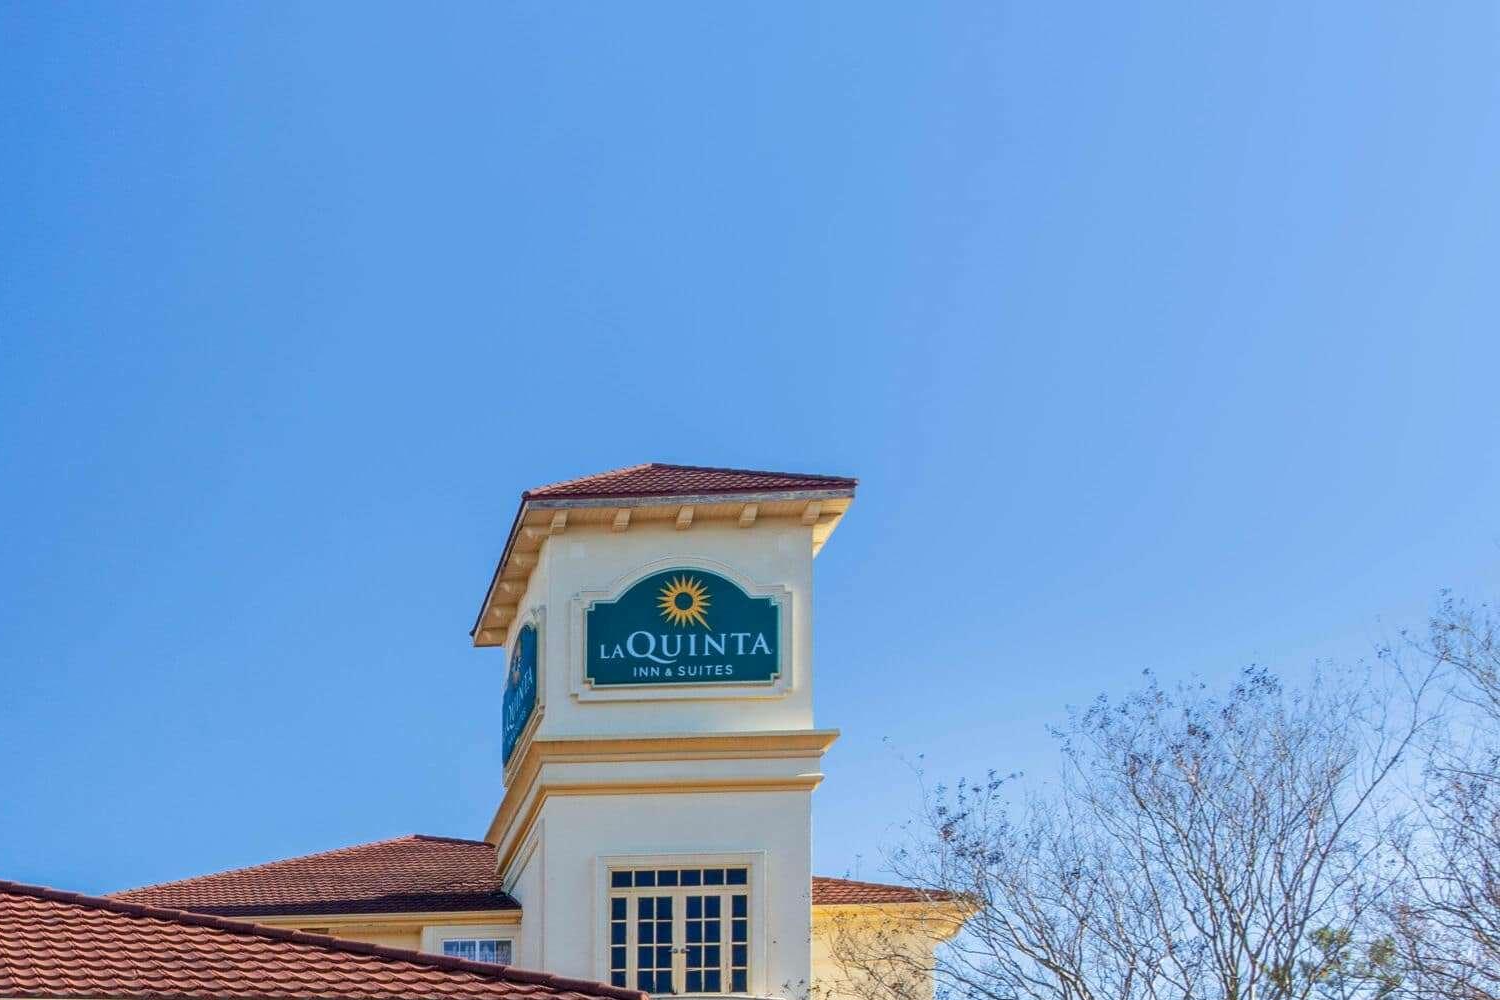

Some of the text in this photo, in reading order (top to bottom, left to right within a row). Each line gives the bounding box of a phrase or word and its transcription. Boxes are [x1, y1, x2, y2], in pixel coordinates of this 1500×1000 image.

[626, 630, 773, 664] QUINTA
[633, 664, 733, 677] INN & SUITES
